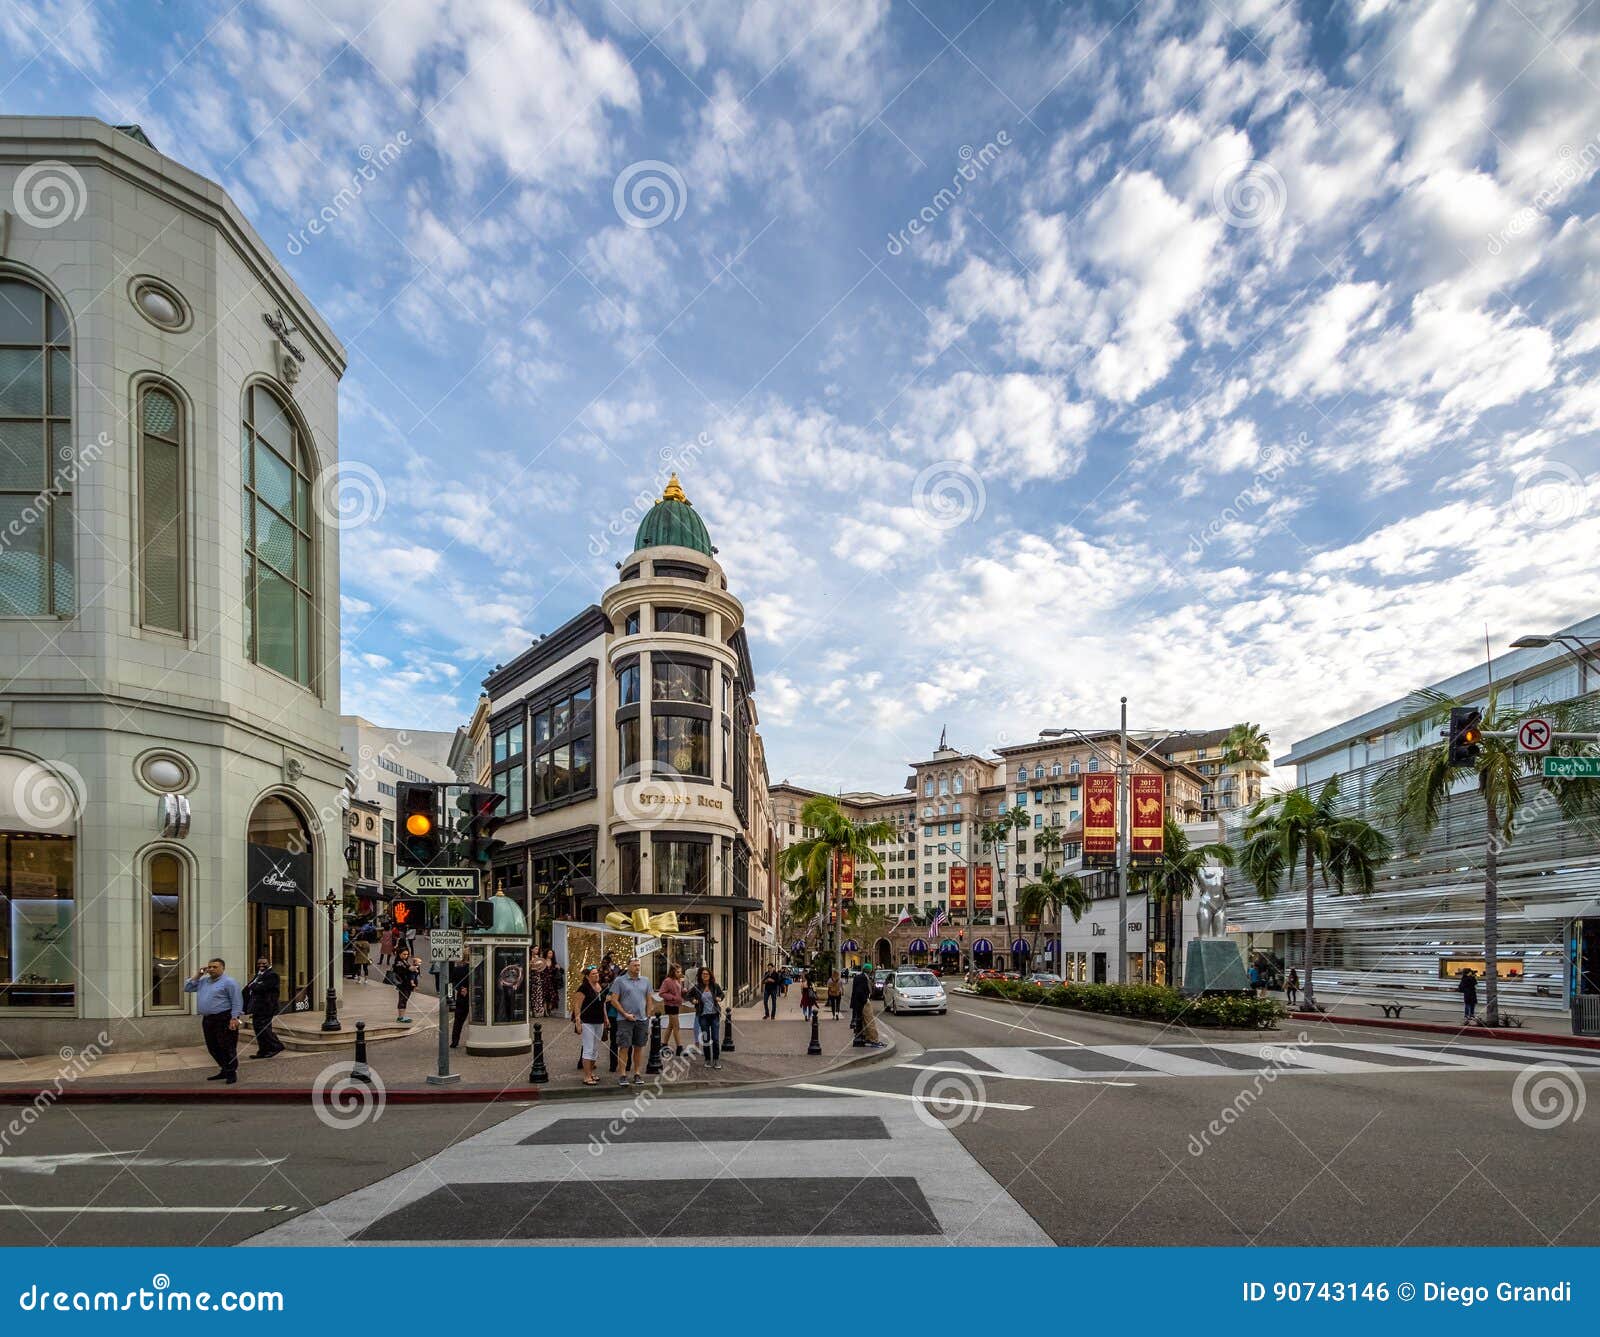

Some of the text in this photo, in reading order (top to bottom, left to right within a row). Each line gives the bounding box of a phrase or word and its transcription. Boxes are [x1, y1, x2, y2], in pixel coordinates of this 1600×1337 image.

[1550, 761, 1592, 773] Dayton
[418, 877, 469, 887] ONE WAY
[431, 948, 444, 958] OK
